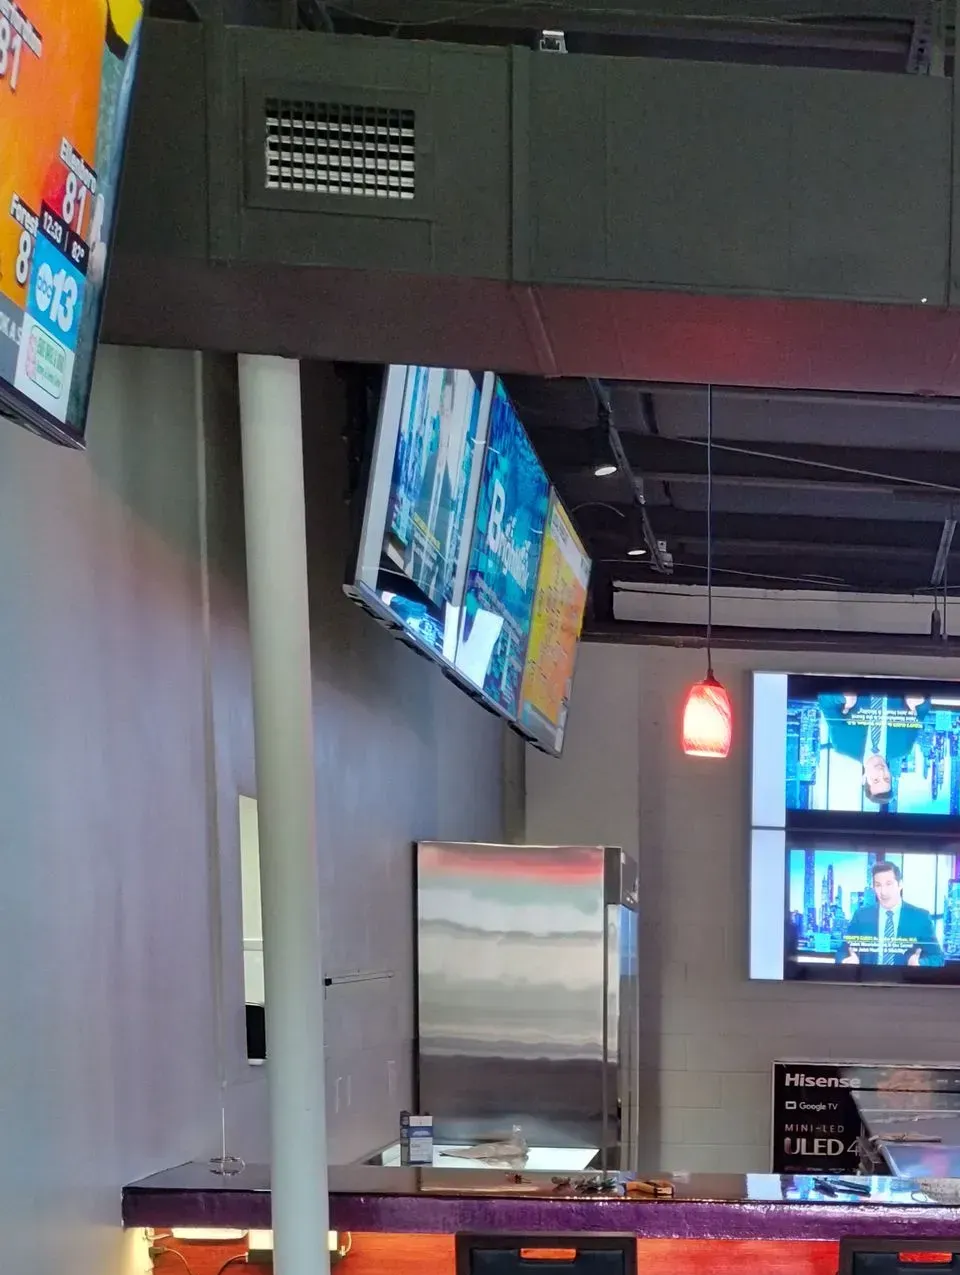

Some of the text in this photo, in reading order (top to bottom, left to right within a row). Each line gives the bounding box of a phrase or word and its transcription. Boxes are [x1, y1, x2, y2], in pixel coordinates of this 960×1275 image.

[62, 171, 87, 236] 81
[16, 229, 33, 284] 8
[49, 268, 78, 333] 13
[784, 1073, 861, 1089] Hisense
[799, 1101, 839, 1112] Google TV
[783, 1137, 845, 1156] ULED
